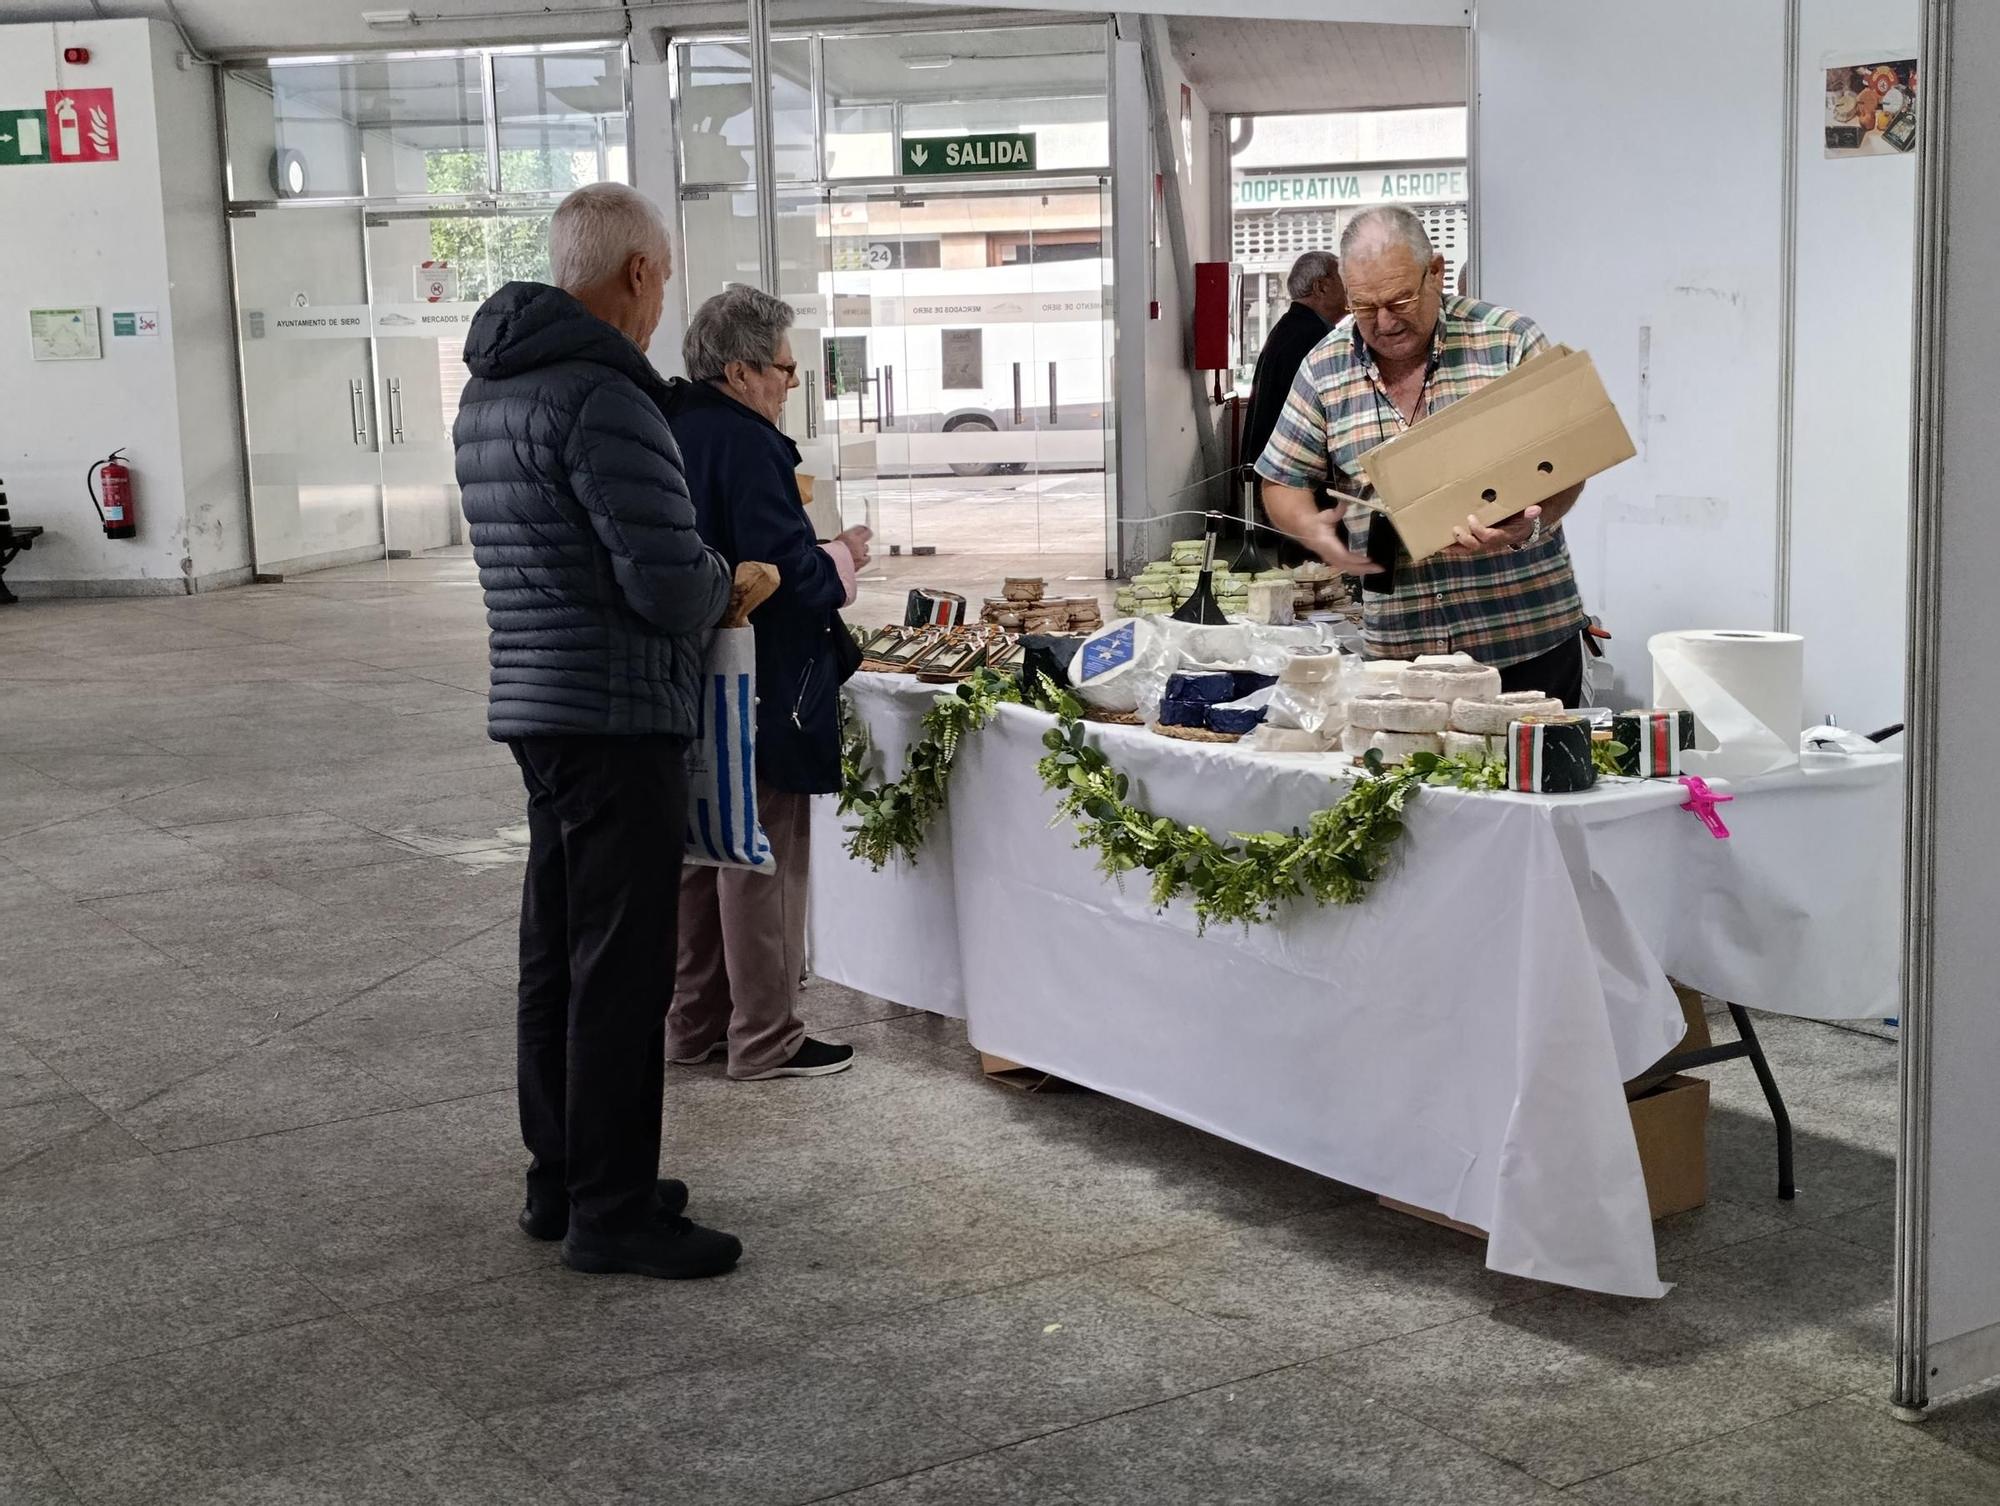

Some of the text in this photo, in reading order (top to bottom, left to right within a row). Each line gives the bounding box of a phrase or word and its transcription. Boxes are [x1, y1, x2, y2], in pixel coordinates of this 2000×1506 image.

[945, 140, 1028, 166] SALIDA
[1380, 170, 1467, 198] AGROPE
[870, 250, 889, 263] 24
[796, 307, 817, 315] SIERO
[277, 317, 361, 328] AYUNTAMIENTO DE SIERO
[421, 314, 471, 323] MERCADOS DE
